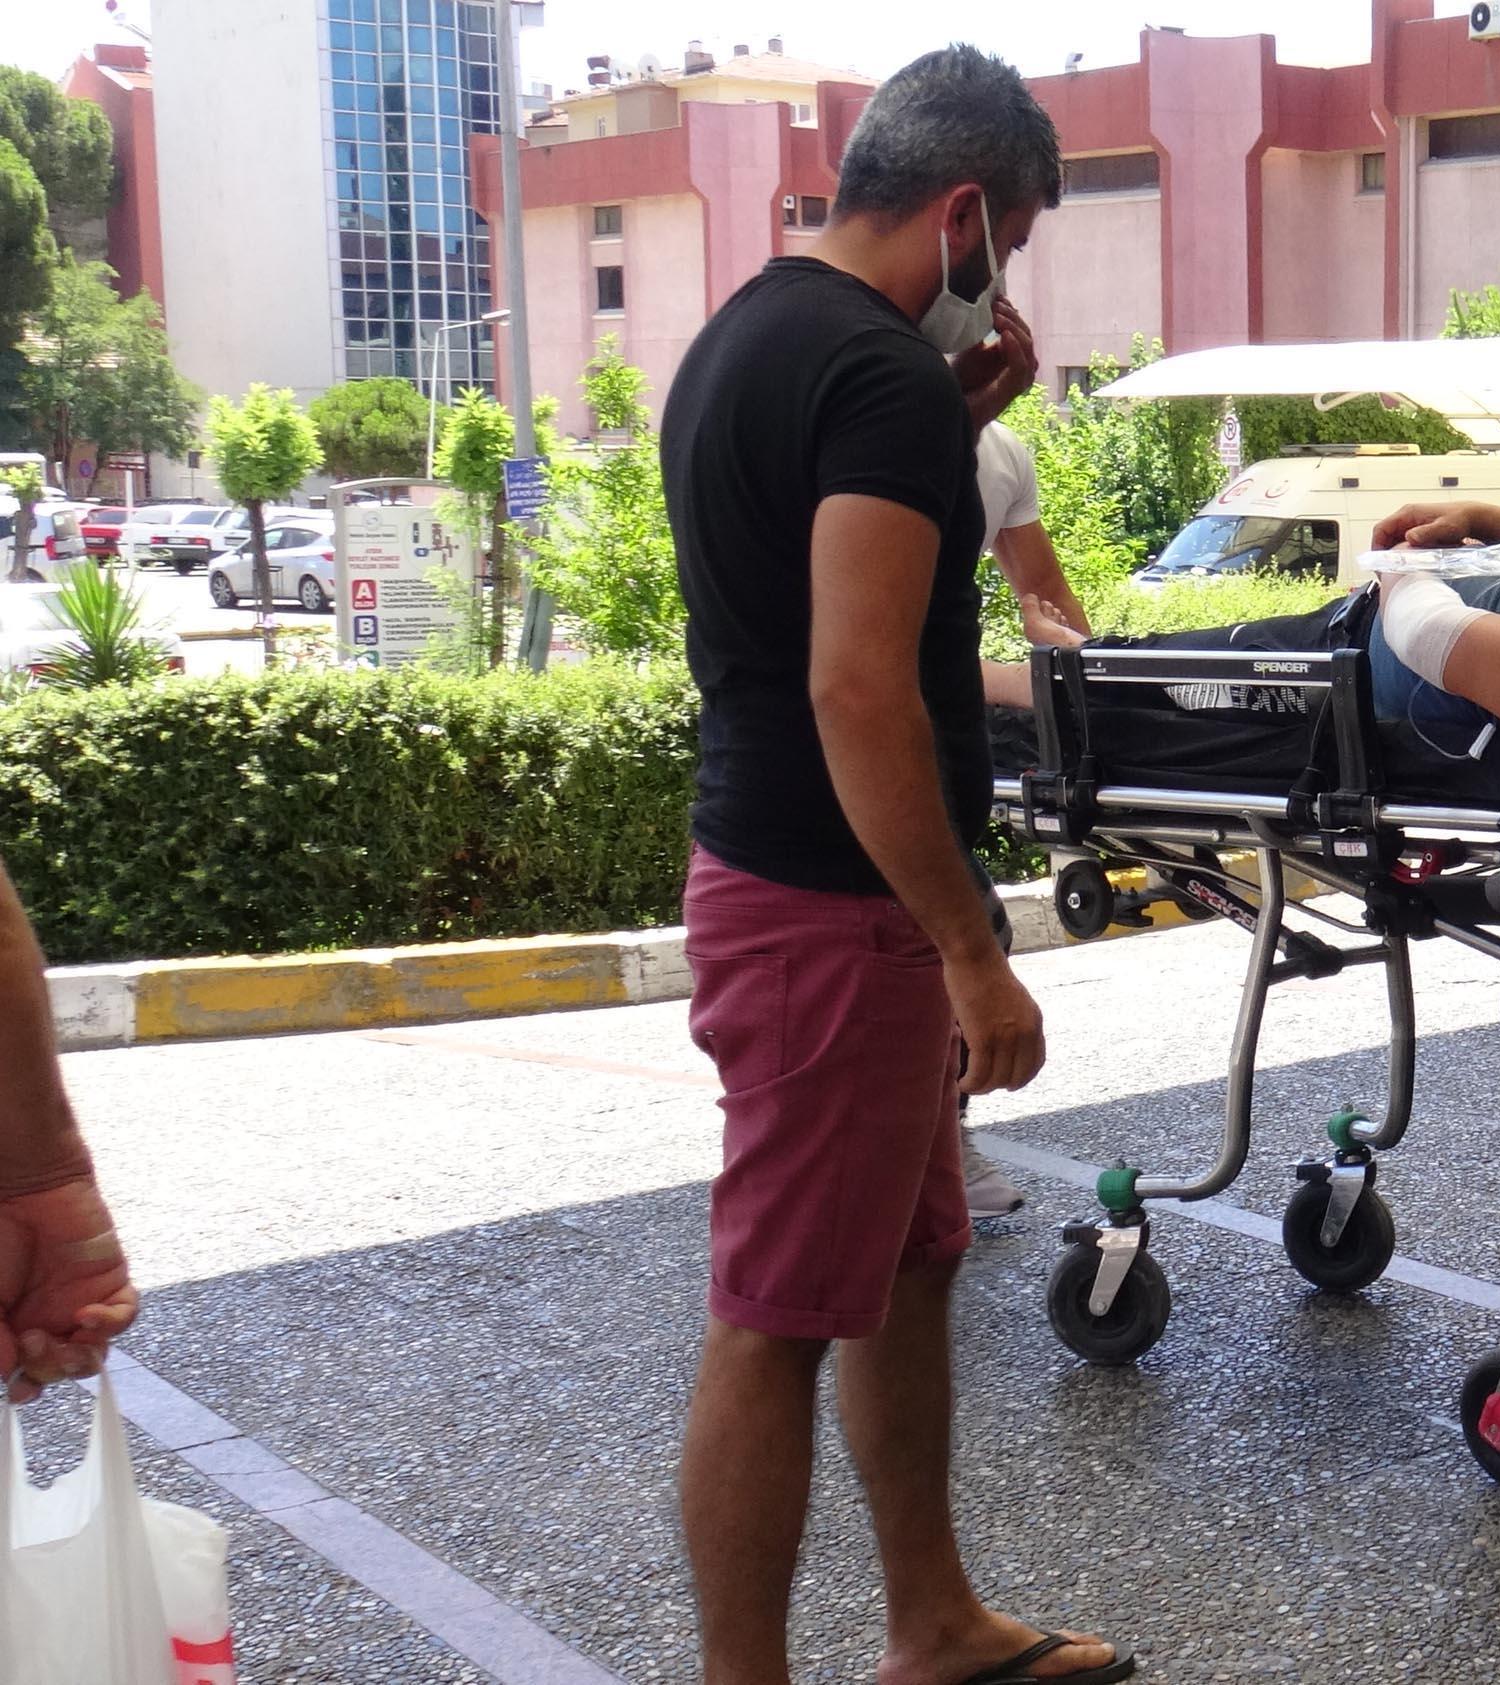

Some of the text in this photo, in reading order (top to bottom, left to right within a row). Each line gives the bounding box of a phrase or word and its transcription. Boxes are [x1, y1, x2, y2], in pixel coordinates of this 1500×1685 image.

[356, 582, 373, 599] A
[360, 617, 375, 636] B
[1253, 661, 1309, 673] SPENCER
